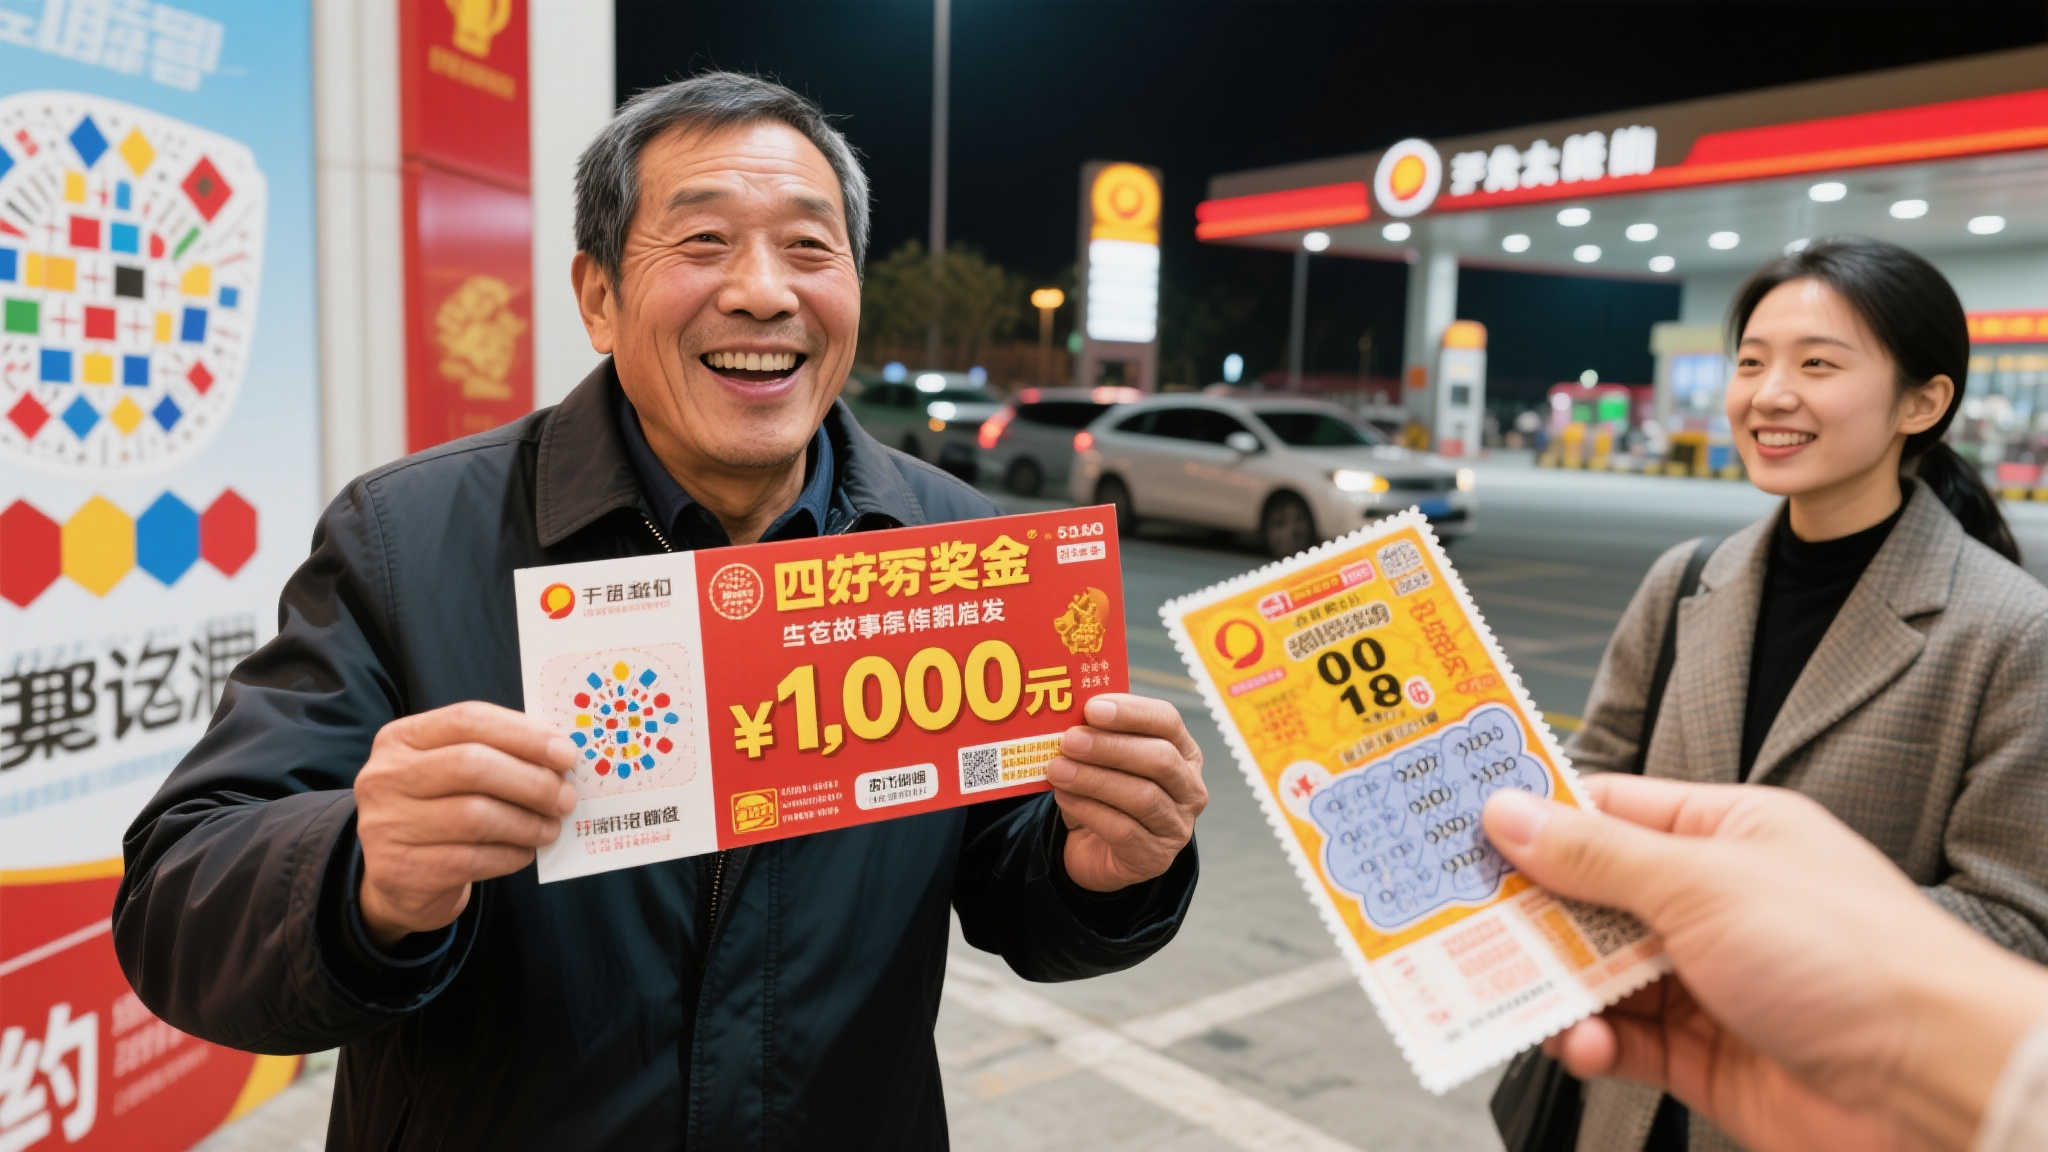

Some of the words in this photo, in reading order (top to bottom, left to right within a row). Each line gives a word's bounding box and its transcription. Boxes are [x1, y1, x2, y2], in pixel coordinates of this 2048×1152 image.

[1316, 637, 1386, 685] 00
[729, 639, 1073, 759] ¥1,000元
[1340, 673, 1402, 716] 18
